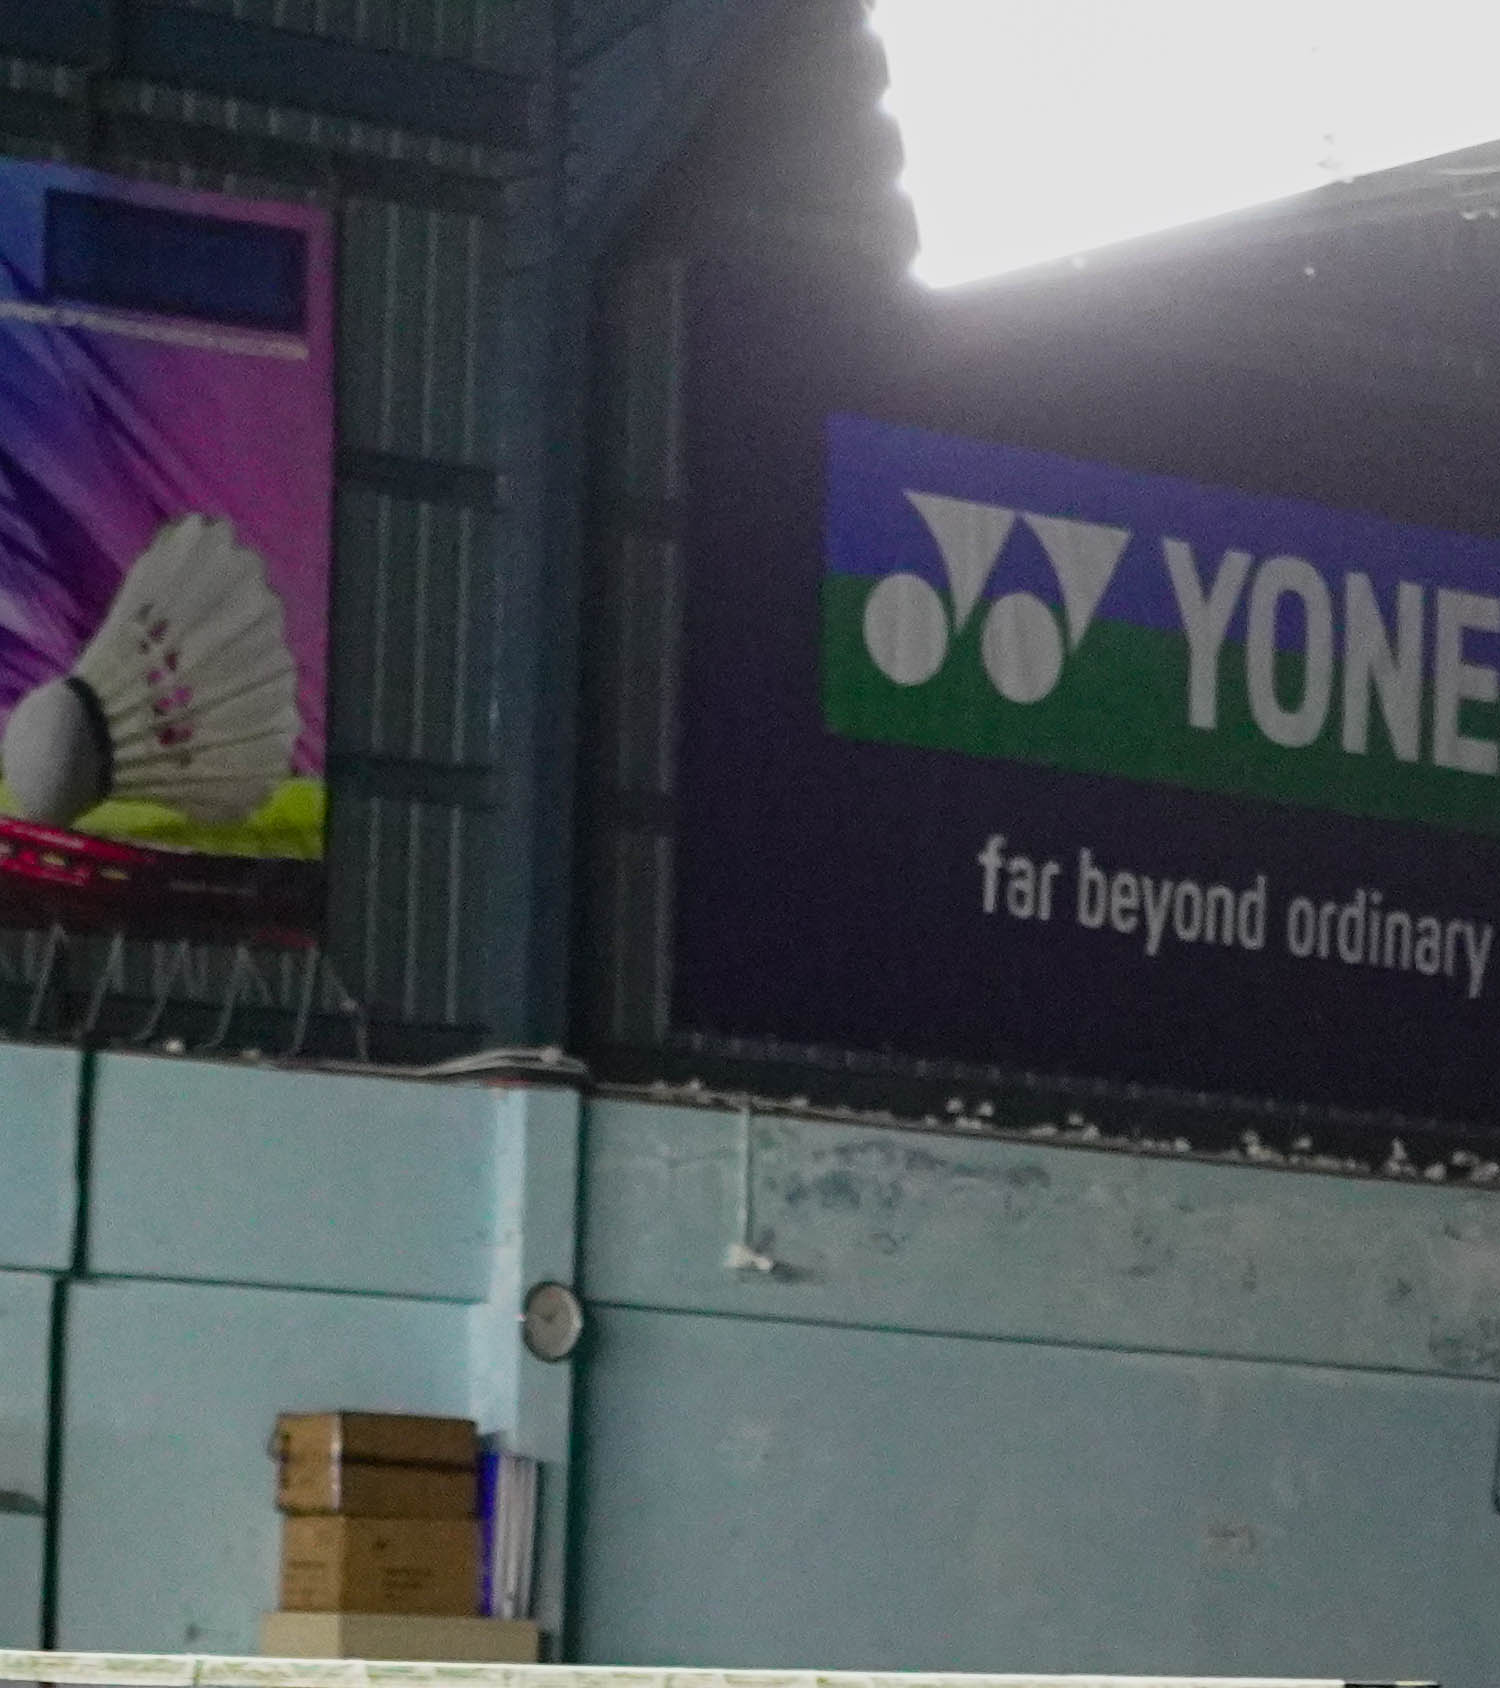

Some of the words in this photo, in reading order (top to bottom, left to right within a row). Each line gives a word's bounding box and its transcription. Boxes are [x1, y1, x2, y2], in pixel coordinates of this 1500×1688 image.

[978, 833, 1062, 922] far
[1077, 847, 1267, 956] beyond
[1288, 888, 1494, 1000] ordinary
